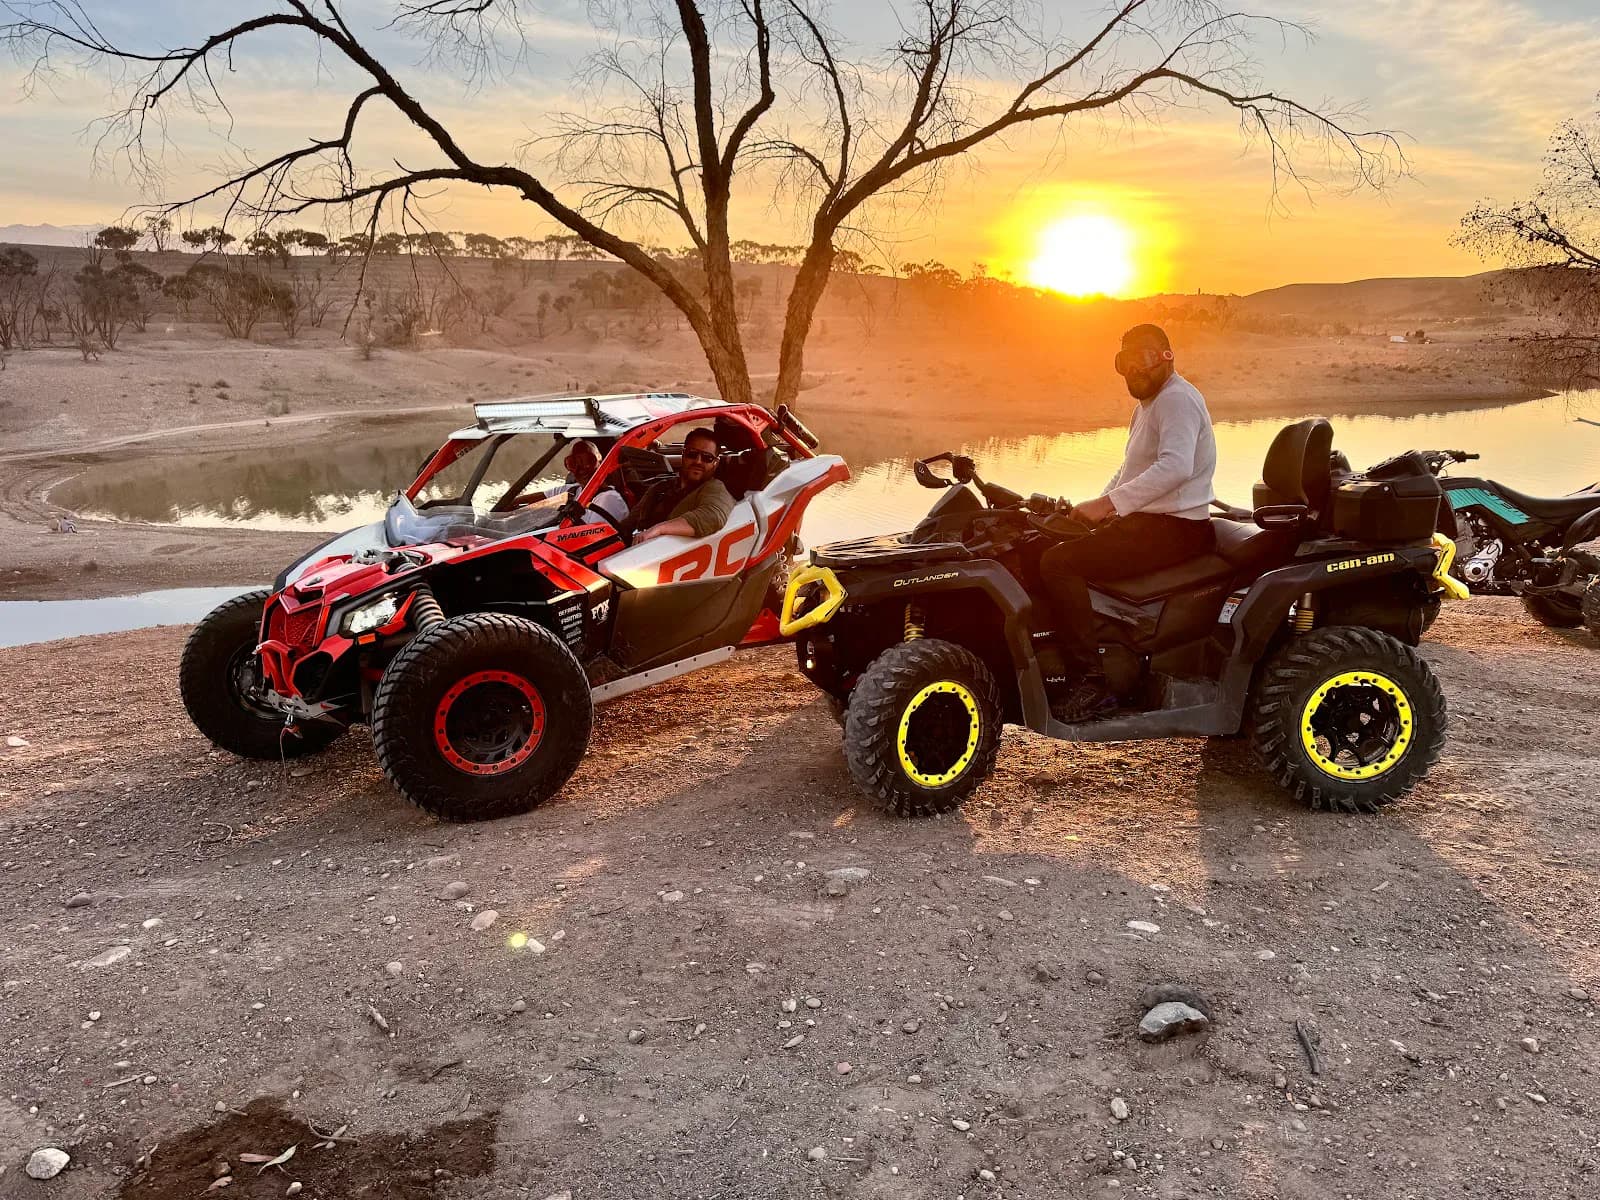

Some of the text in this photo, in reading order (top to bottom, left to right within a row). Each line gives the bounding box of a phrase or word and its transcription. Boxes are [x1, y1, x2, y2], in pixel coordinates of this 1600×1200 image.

[557, 526, 605, 542] MAVERICK
[1327, 552, 1395, 573] can-am
[894, 572, 959, 587] OUTLANDER
